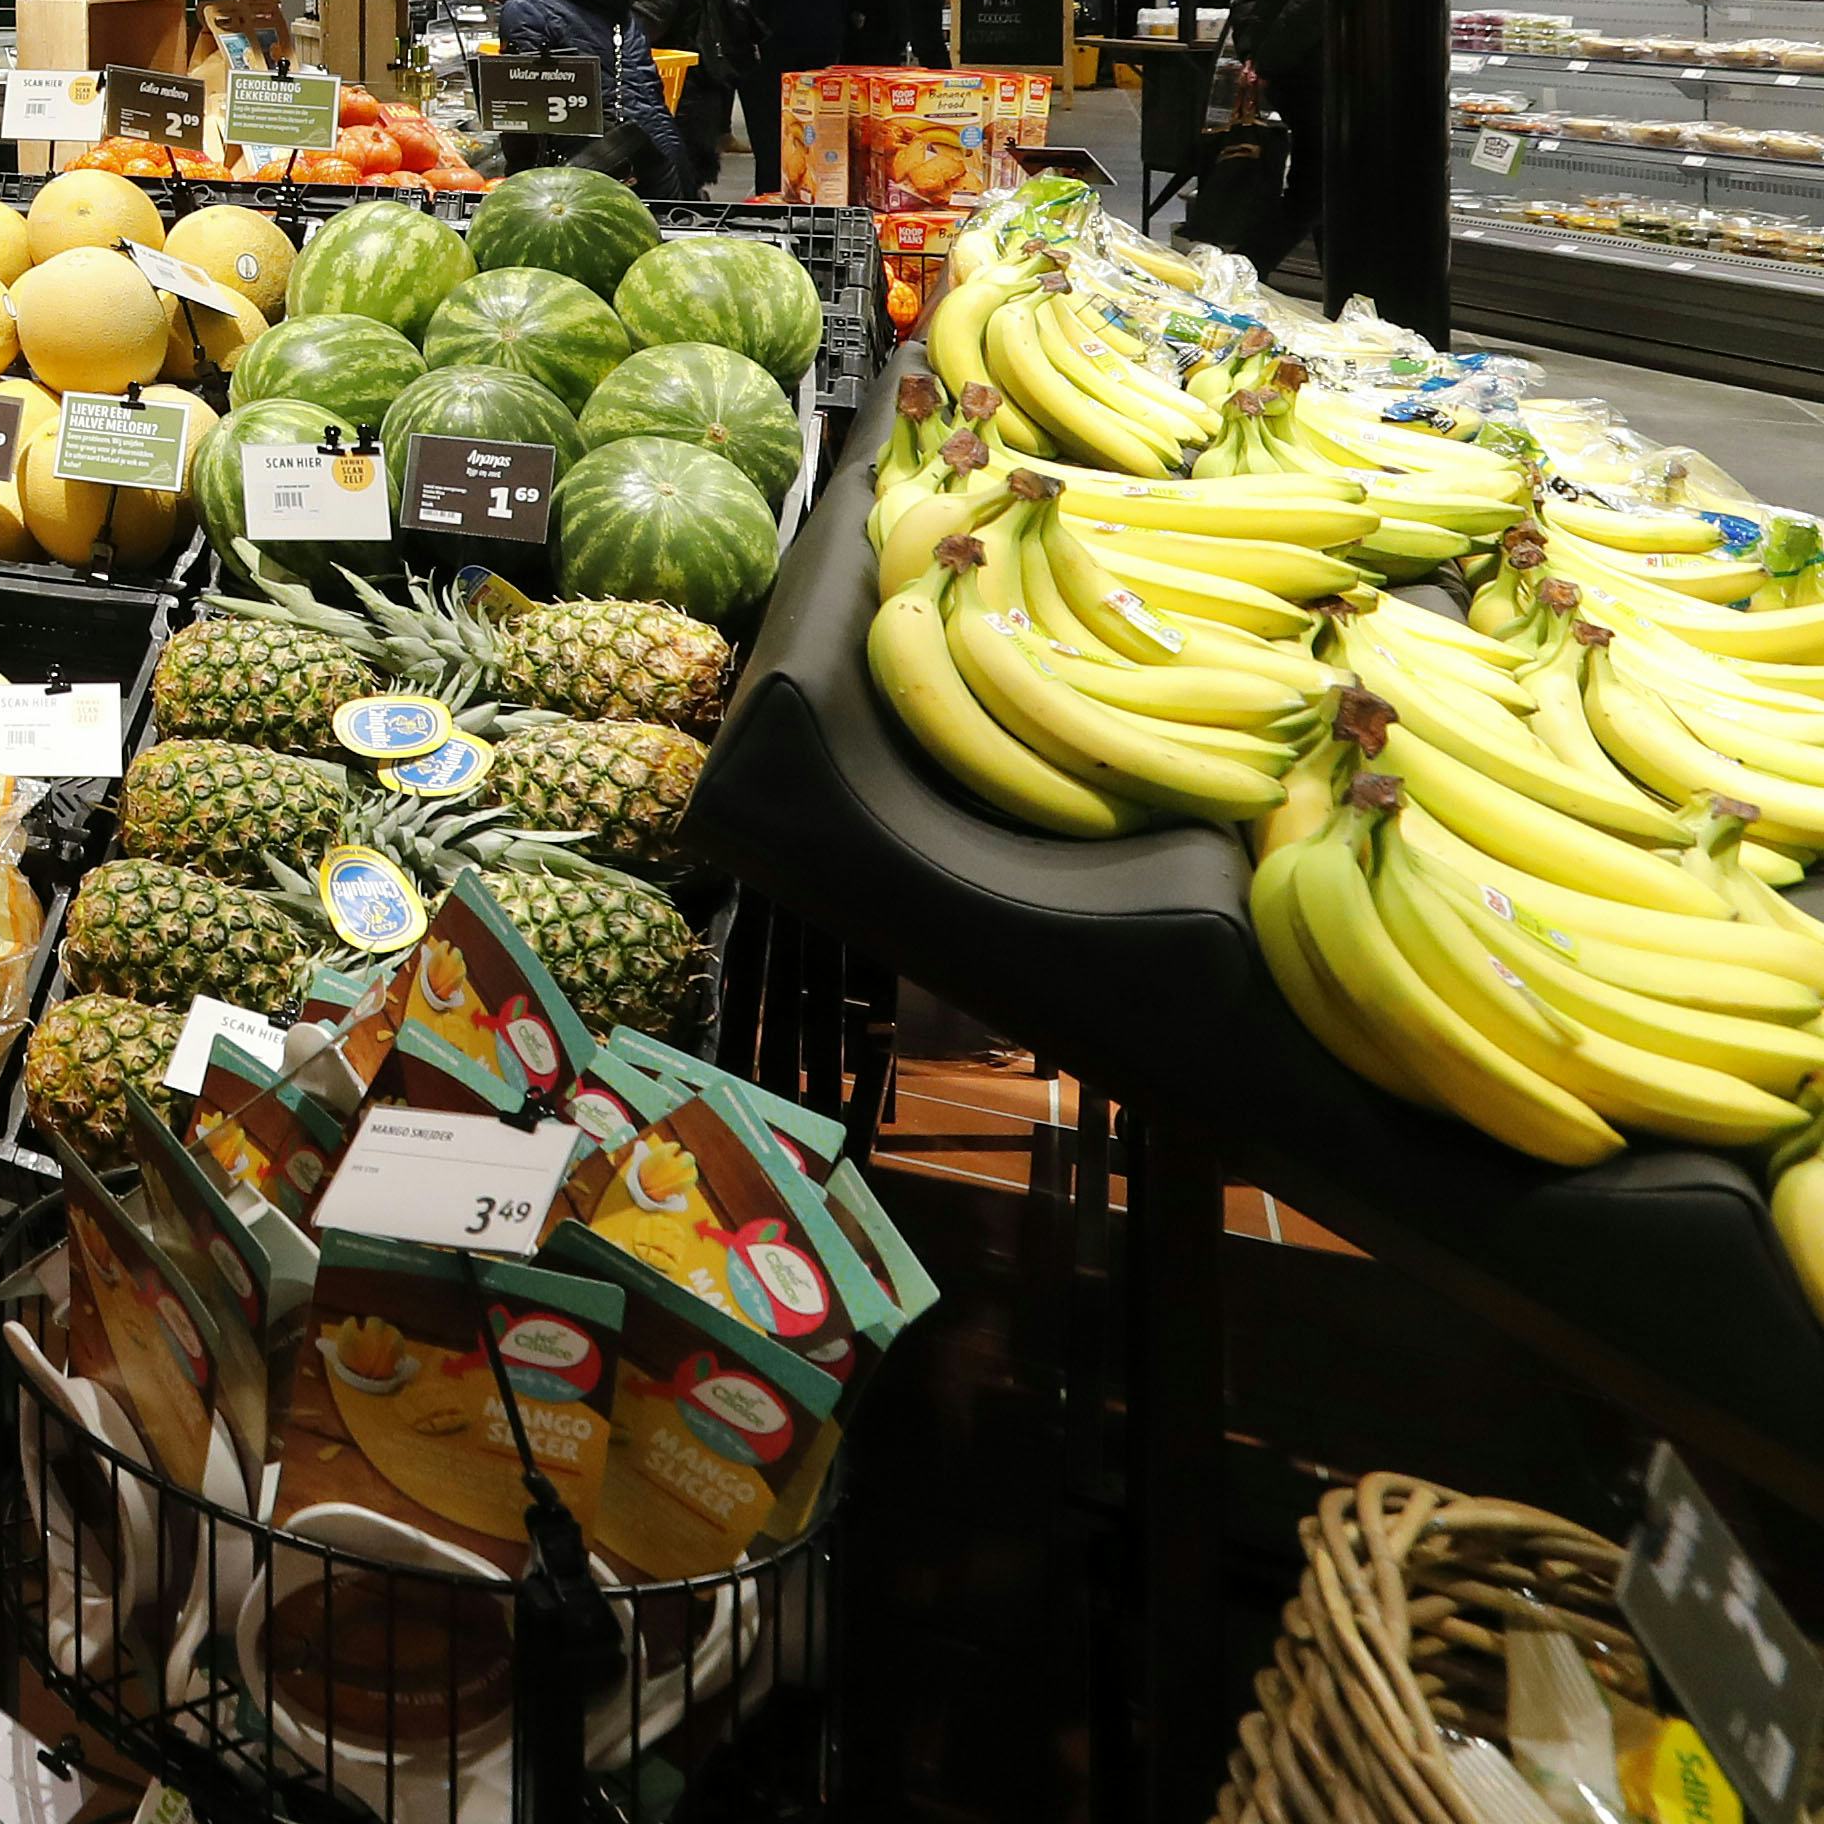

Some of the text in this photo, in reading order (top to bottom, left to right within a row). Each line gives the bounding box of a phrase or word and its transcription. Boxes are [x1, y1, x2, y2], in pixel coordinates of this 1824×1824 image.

[23, 78, 62, 88] SCAN HIER
[509, 68, 539, 81] Water
[235, 78, 301, 94] GEKOELD NOG
[891, 89, 916, 99] KOOP
[235, 91, 293, 104] LEKKERDER!
[70, 402, 132, 421] LIEVER EEN
[69, 416, 158, 436] HALVE MELOEN?
[265, 456, 322, 469] SCAN HIER
[467, 448, 512, 467] Ananas
[341, 467, 364, 475] SCAN
[343, 475, 364, 484] ZELF
[2, 697, 57, 708] SCAN HIER
[368, 704, 389, 749] Chiquita
[427, 742, 468, 788] Chiquita
[333, 876, 400, 900] Chiquita
[220, 1016, 256, 1037] SCAN
[370, 1124, 454, 1143] MANGO SNIJDER
[483, 1395, 593, 1439] MANGO
[651, 1427, 757, 1504] MANGO
[644, 1453, 736, 1520] SLICER
